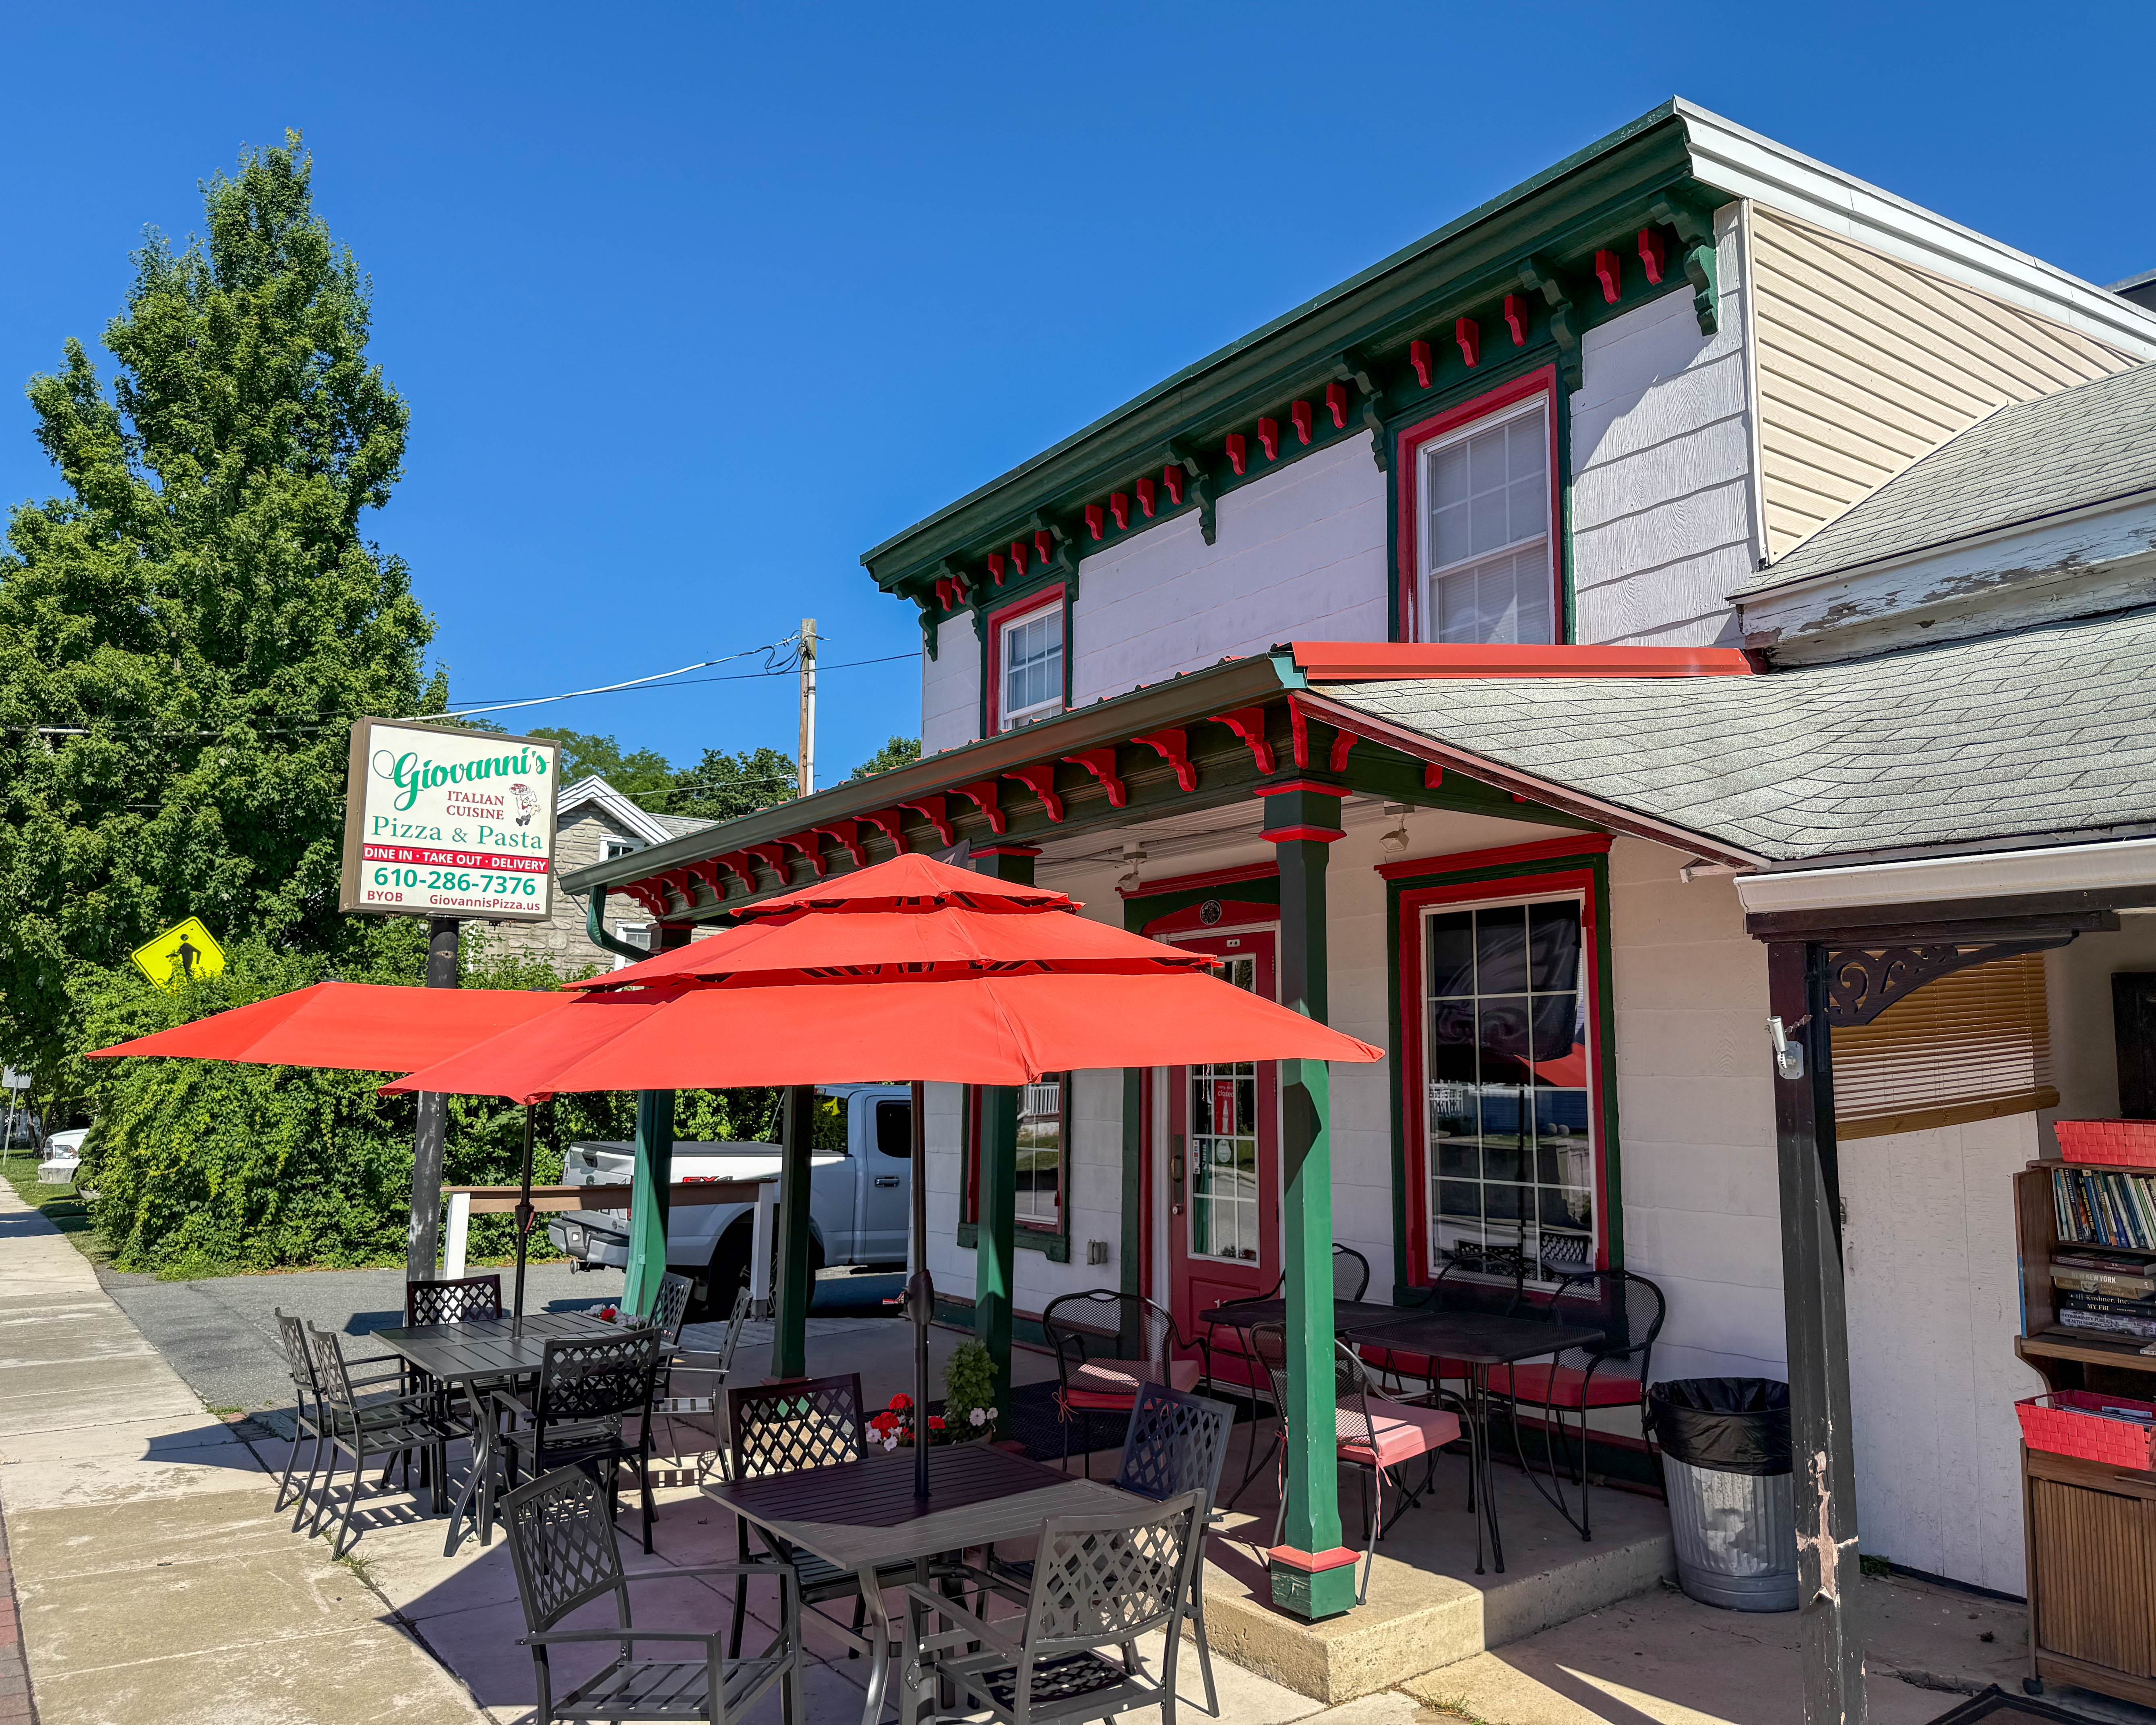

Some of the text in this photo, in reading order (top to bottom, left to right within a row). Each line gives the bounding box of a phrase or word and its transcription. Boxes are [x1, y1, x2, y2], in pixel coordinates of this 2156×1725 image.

[373, 747, 550, 811] Giovanni's
[447, 790, 504, 806] ITALIAN
[446, 805, 504, 820] CUISINE
[371, 816, 543, 849] Pizza & Pasta
[364, 847, 546, 871] DINE IN TAKE OUT DELIVERY
[374, 867, 535, 896] 610-286-7376
[367, 890, 540, 911] BYOB GiovannisPizza.us
[2099, 1275, 2116, 1284] YORK
